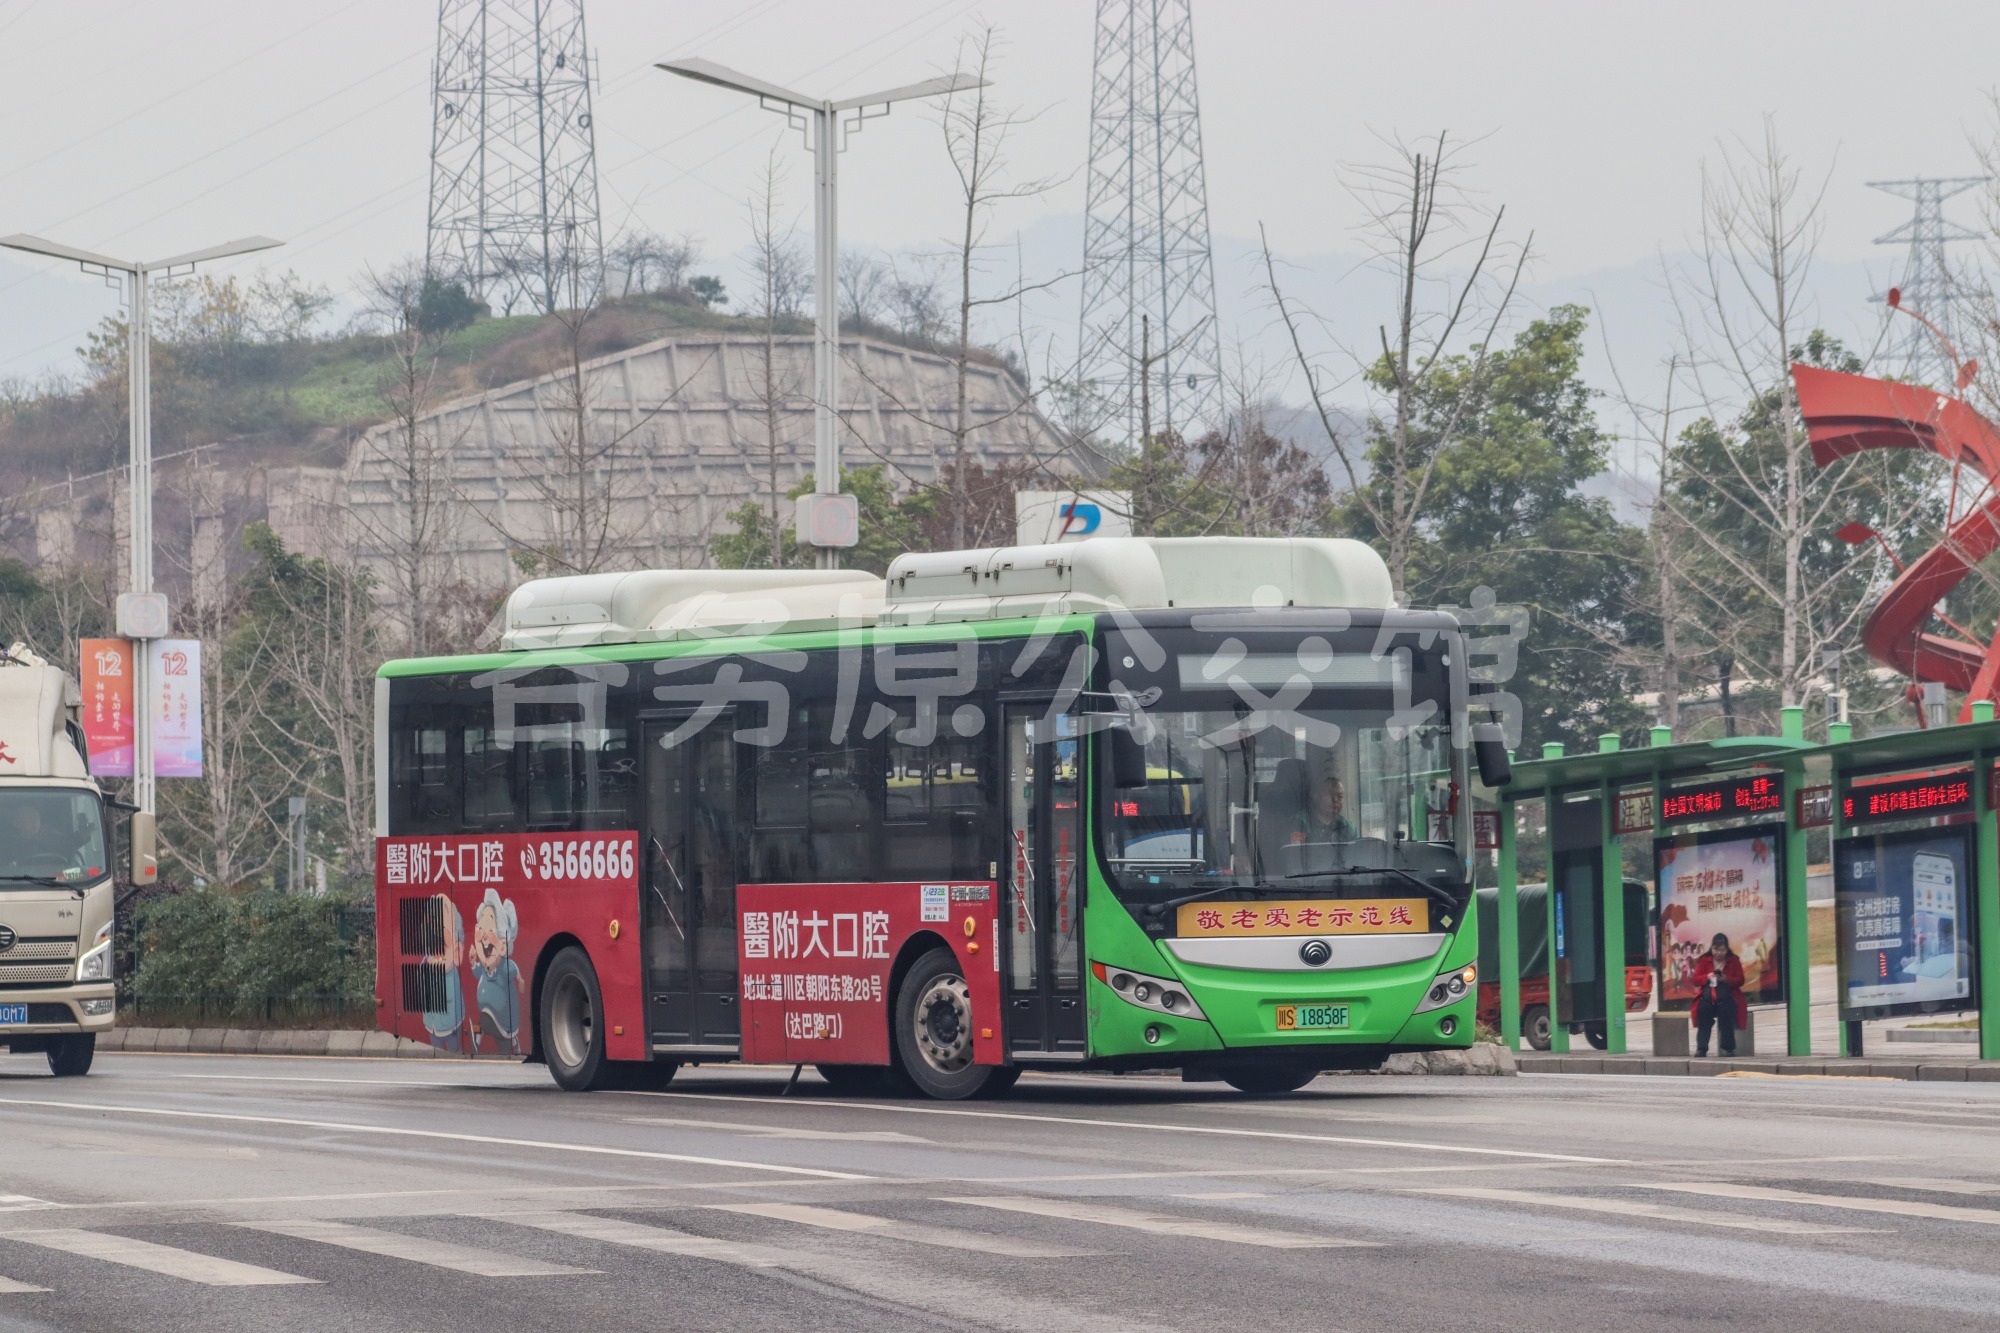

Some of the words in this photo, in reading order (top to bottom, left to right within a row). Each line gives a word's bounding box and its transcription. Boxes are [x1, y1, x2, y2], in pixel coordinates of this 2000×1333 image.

[95, 651, 122, 676] 12
[161, 652, 188, 676] 12
[386, 842, 504, 884] 醫附大口腔
[539, 840, 633, 880] 3566666
[1197, 906, 1413, 930] 敬老爱老示范线
[1855, 896, 1901, 918] 达州找好房
[743, 910, 890, 959] 醫附大口腔
[1855, 916, 1902, 938] 贝壳真保障
[0, 1007, 25, 1021] 0M7
